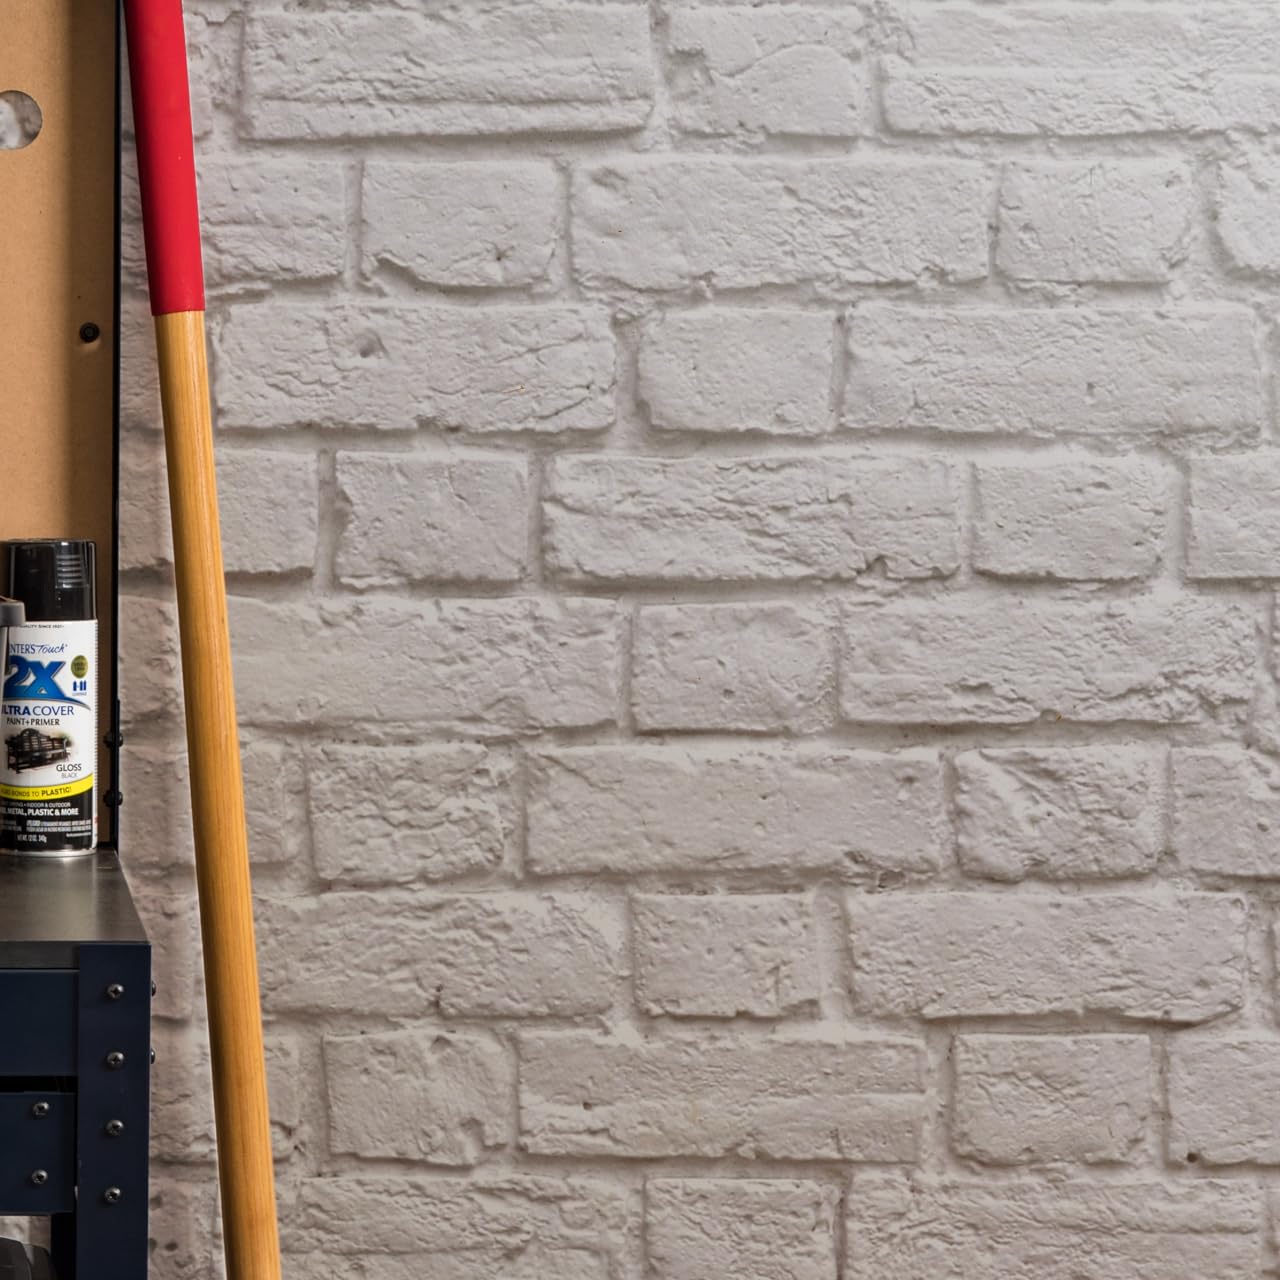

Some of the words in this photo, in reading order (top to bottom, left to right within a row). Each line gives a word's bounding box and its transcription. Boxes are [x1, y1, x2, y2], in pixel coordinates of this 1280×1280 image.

[35, 643, 65, 654] Touch
[3, 655, 67, 698] 2X
[32, 705, 75, 716] COVER
[56, 763, 82, 772] GLOSS
[41, 786, 72, 797] PLASTIC!
[27, 807, 54, 817] PLASTIC
[54, 808, 60, 816] &
[61, 807, 79, 816] MORE
